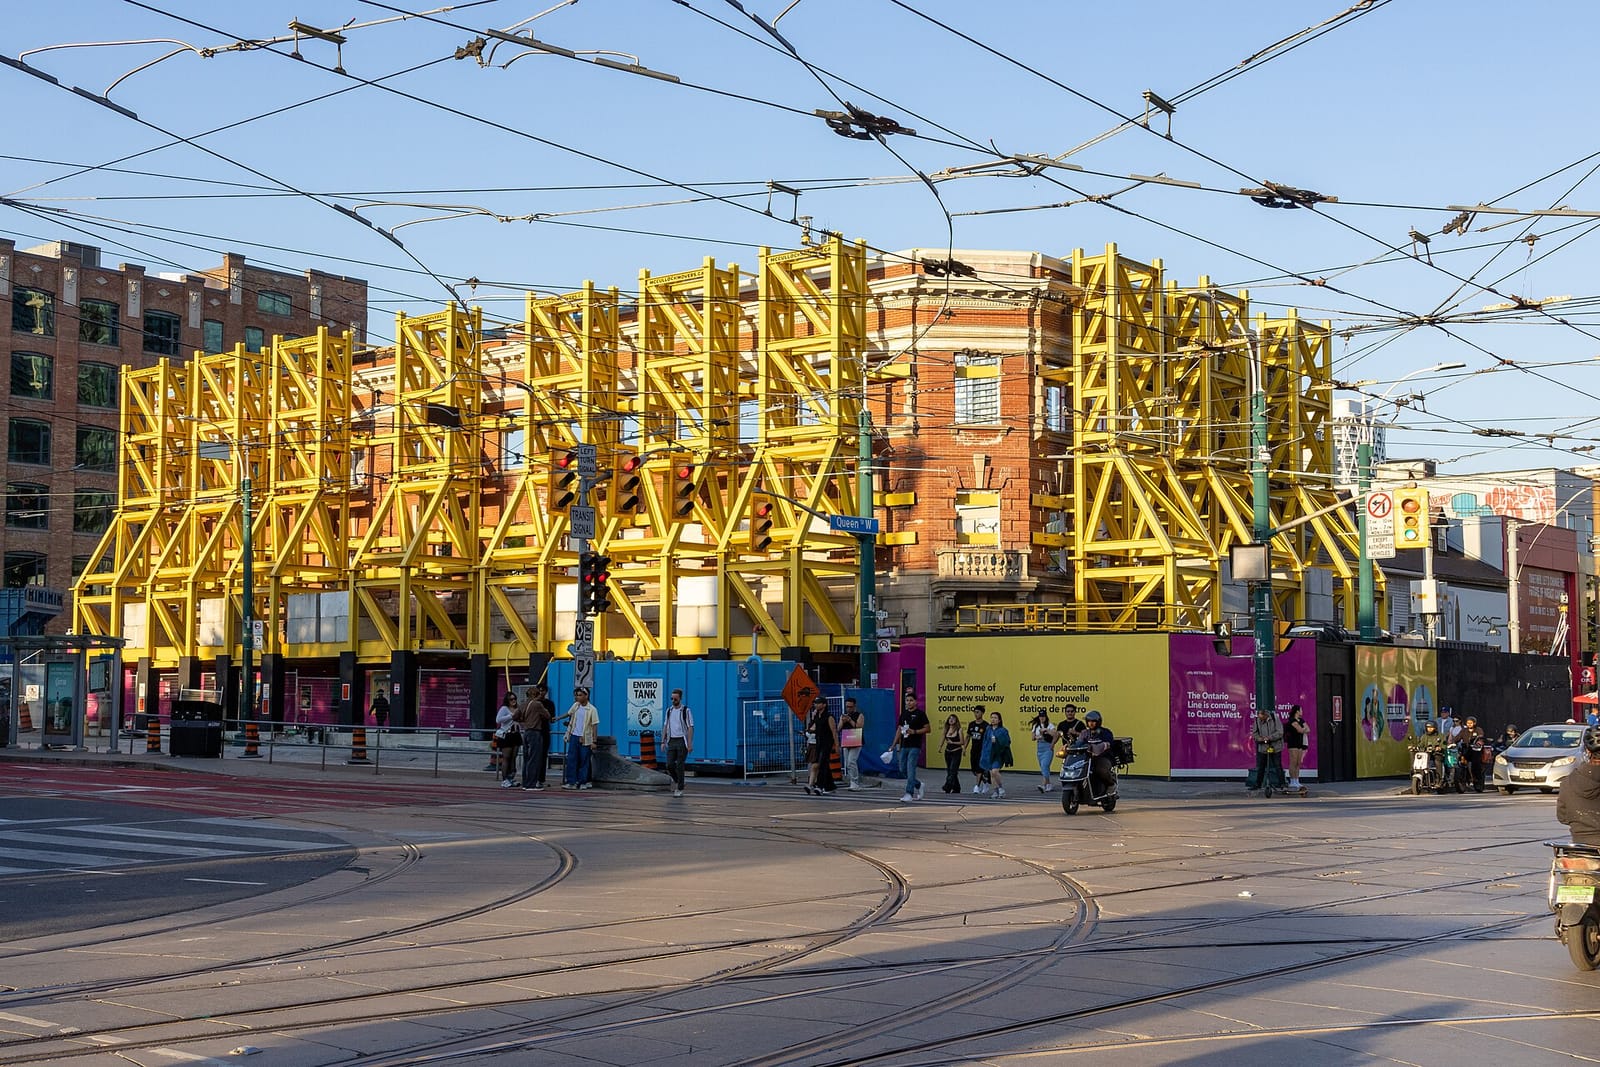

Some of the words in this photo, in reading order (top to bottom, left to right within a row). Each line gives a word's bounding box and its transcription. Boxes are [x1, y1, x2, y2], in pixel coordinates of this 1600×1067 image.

[580, 447, 594, 455] LEFT
[580, 456, 594, 464] TURN
[572, 510, 594, 520] TRANSIT
[836, 516, 859, 529] Queen
[865, 519, 872, 530] W
[573, 523, 593, 535] SIGNAL
[632, 681, 658, 689] ENVIRO
[938, 683, 962, 691] Future
[964, 683, 985, 691] home
[987, 683, 996, 691] of
[1020, 683, 1041, 692] Futur
[1043, 683, 1098, 694] emplacement
[633, 690, 657, 699] TANK
[938, 695, 955, 703] your
[975, 693, 1004, 704] subway
[1019, 694, 1030, 702] de
[1031, 694, 1053, 702] votre
[1055, 694, 1089, 702] nouvelle
[1187, 691, 1200, 699] The
[1202, 692, 1229, 700] Ontario
[938, 704, 976, 712] connectio
[1049, 704, 1060, 712] de
[1187, 700, 1203, 709] Line
[1203, 701, 1209, 709] is
[1210, 701, 1236, 711] coming
[1277, 702, 1295, 710] arriv
[1196, 710, 1221, 718] Queen
[1221, 711, 1242, 719] West.
